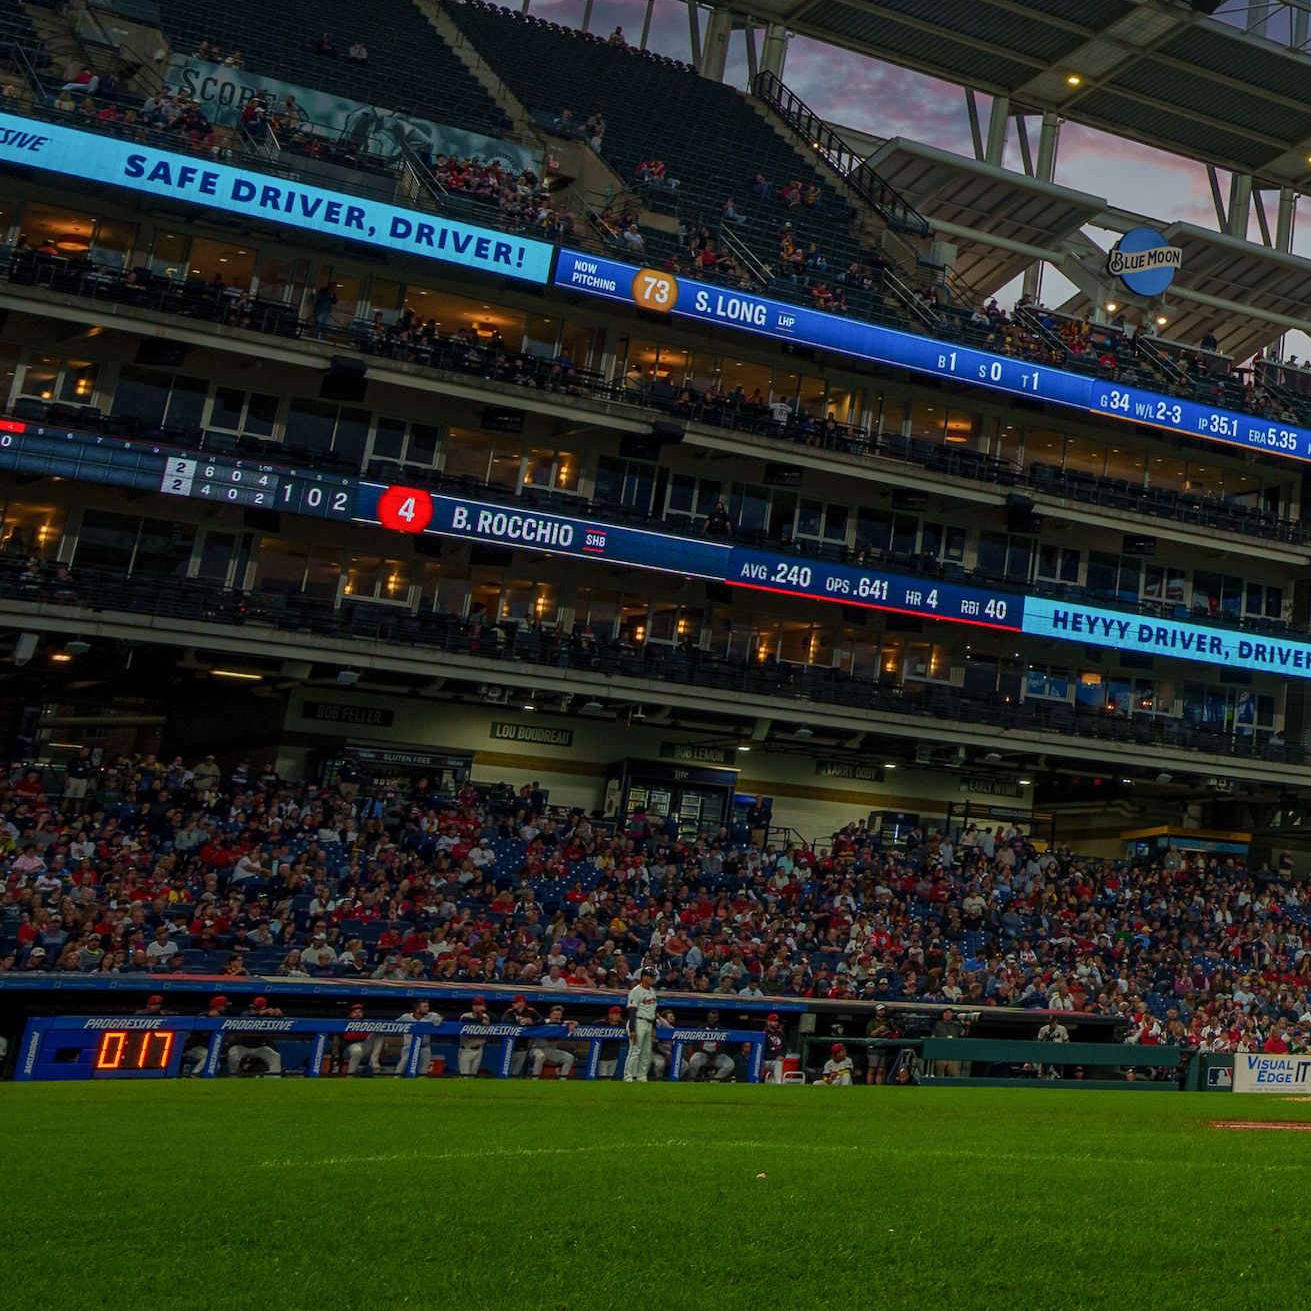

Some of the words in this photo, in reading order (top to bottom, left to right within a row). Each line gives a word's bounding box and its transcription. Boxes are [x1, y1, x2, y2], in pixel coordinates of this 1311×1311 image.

[124, 153, 220, 195] SAFE
[230, 178, 376, 237] DRIVER,
[389, 216, 526, 268] DRIVER!
[574, 260, 598, 275] NOW
[1111, 252, 1145, 273] BLUE
[1147, 250, 1180, 266] MOON
[572, 272, 616, 292] PITCHING
[642, 276, 670, 304] 73
[695, 291, 712, 313] S.
[717, 294, 767, 326] LONG
[778, 315, 795, 327] LHP
[398, 497, 416, 522] 4
[452, 506, 472, 530] B.
[477, 510, 574, 546] ROCCHIO
[586, 534, 606, 548] SHB
[740, 562, 767, 580] AVG
[770, 563, 812, 588] .240
[826, 577, 850, 594] OPS
[853, 577, 889, 601] .641
[905, 590, 921, 606] HR
[926, 589, 938, 609] 4
[984, 599, 1007, 620] 40
[1053, 609, 1130, 640] HEYYY
[1137, 624, 1230, 661] DRIVER,
[317, 704, 340, 721] BOB
[342, 707, 382, 724] FELLER
[496, 723, 516, 739] LOU
[517, 725, 569, 745] BOUDREAU
[383, 753, 411, 763] GLUTEN
[413, 756, 431, 765] FREE
[674, 745, 692, 760] BOB
[693, 747, 724, 762] LEMON
[969, 778, 993, 794] EARLY
[994, 779, 1017, 795] WYNN
[84, 1018, 163, 1029] PROGRESSIVE
[221, 1019, 294, 1031] PROGRESSIVE
[345, 1022, 412, 1033] PROGRESSIVE
[460, 1025, 522, 1036] PROGRESSIVE
[568, 1027, 626, 1038] PROGRESSIVE
[673, 1030, 728, 1040] PROGRESSIVE
[24, 1031, 40, 1075] PROGRESSIVE
[1248, 1056, 1294, 1070] VISUAL
[1257, 1071, 1292, 1083] EDGE
[1295, 1061, 1311, 1083] IT
